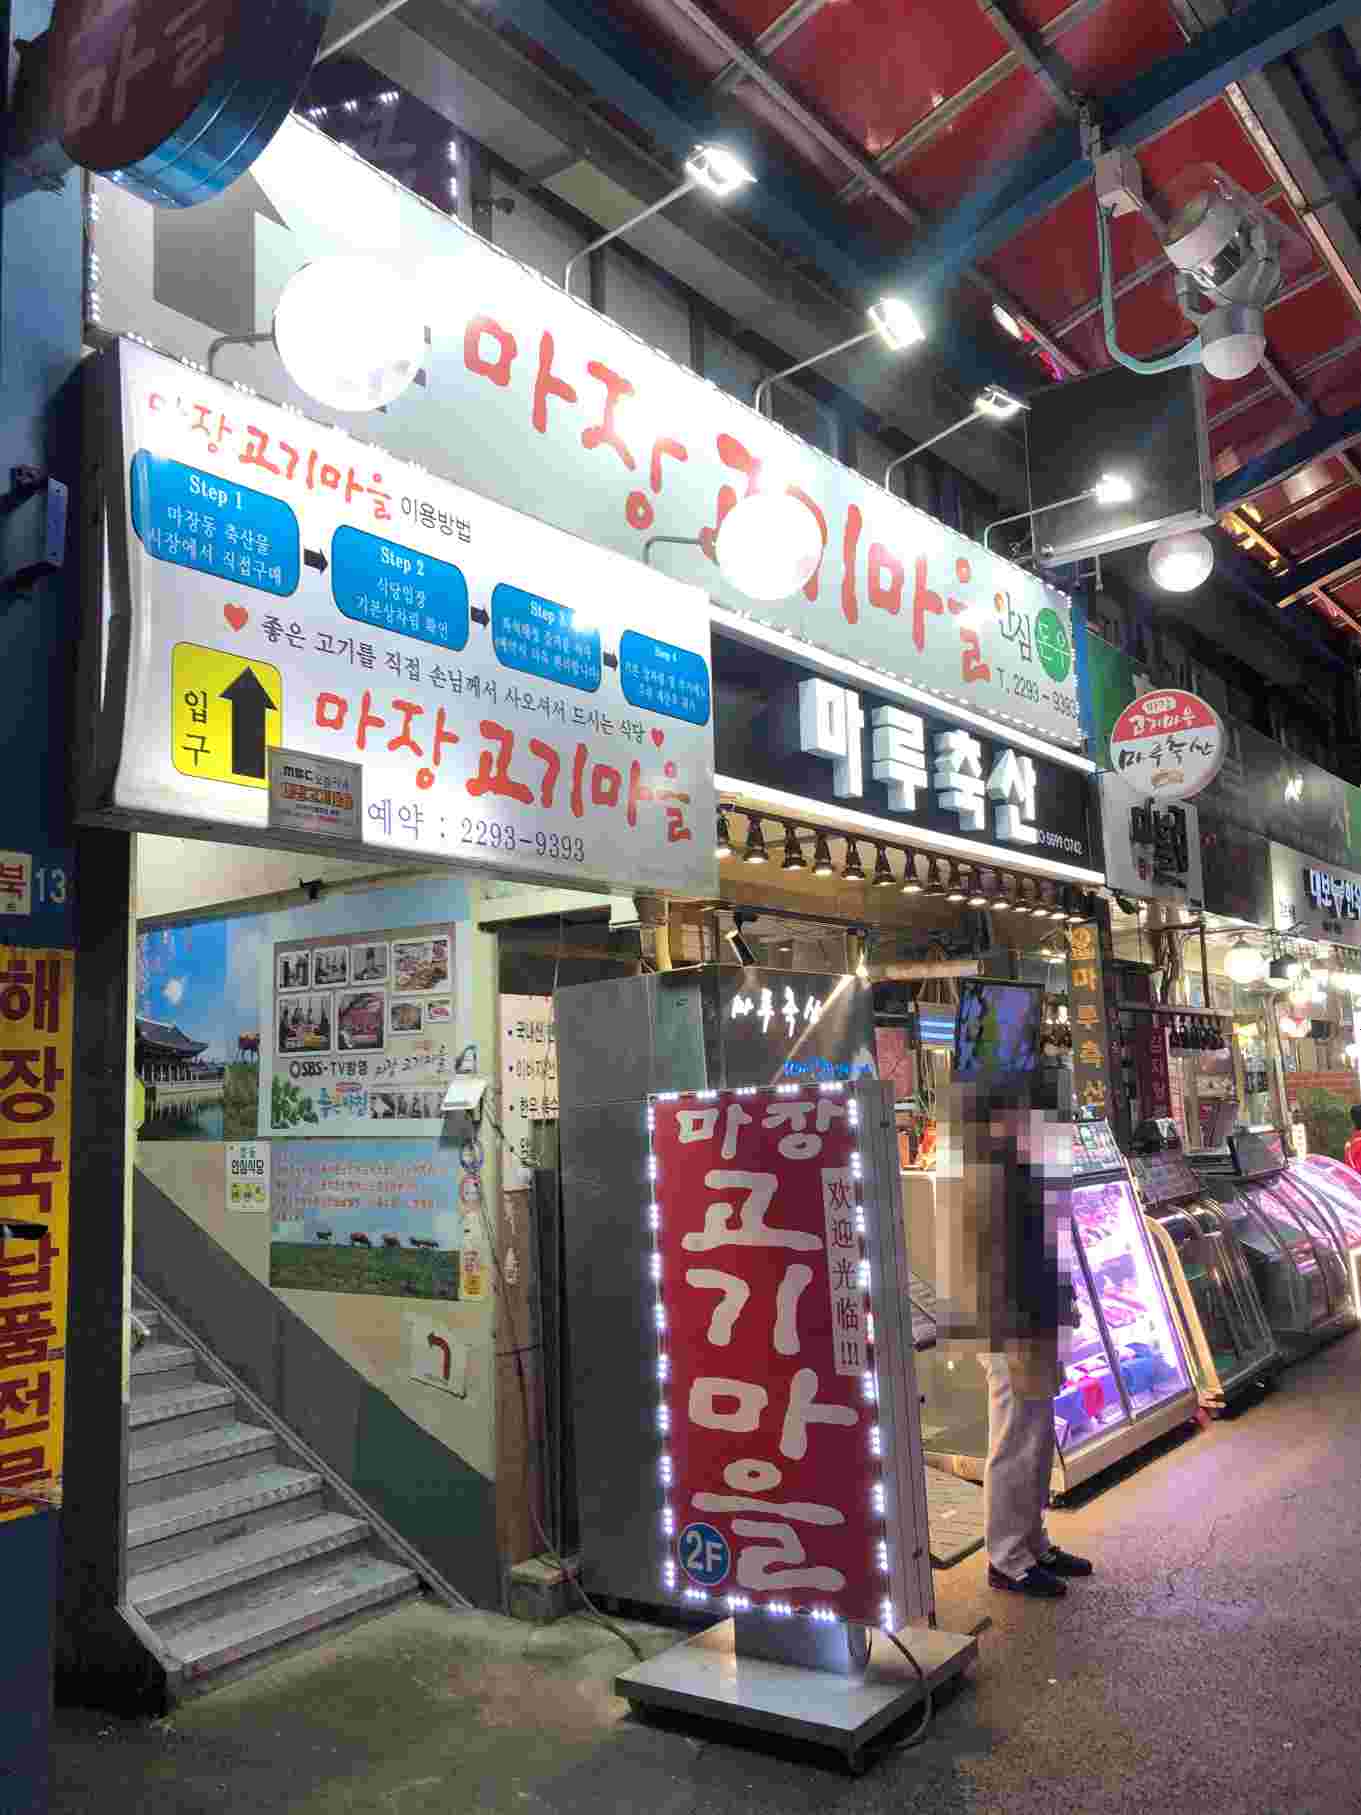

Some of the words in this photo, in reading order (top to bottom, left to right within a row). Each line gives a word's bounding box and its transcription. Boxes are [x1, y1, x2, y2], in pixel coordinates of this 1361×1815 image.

[188, 474, 231, 507] Step
[167, 505, 217, 538] 마장동
[401, 496, 472, 544] 이용방법
[379, 547, 414, 576] Step
[262, 613, 305, 648] 좋은
[313, 632, 376, 669] 고기를
[383, 649, 421, 682] 직접
[428, 664, 497, 705] 손님께서
[504, 687, 568, 723] 사오셔서
[573, 704, 615, 736] 드시는
[620, 721, 647, 744] 식당
[315, 688, 691, 842] 마장고기마을
[797, 676, 1040, 846] 마루축산
[461, 817, 586, 864] 2293-9393
[685, 1530, 723, 1573] 2F
